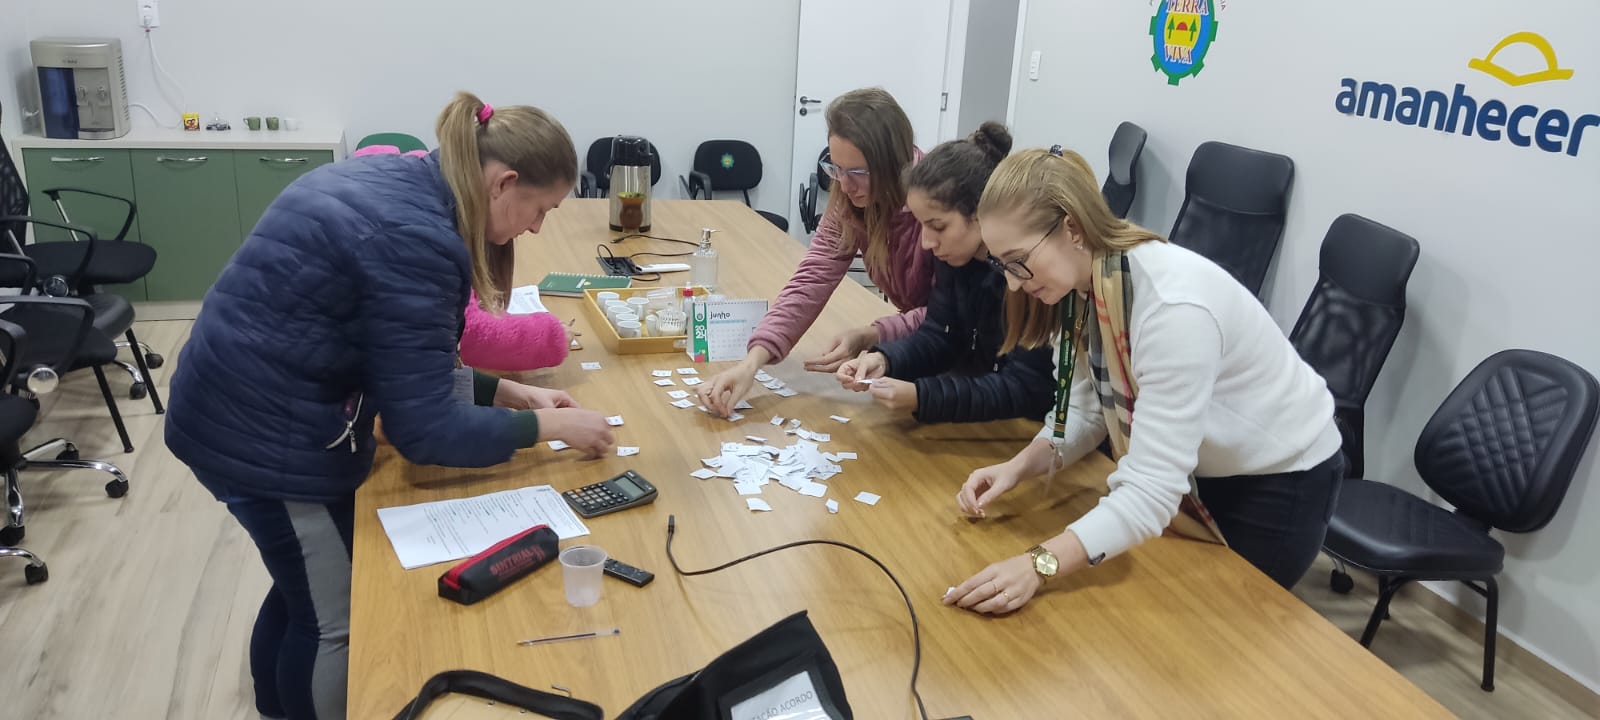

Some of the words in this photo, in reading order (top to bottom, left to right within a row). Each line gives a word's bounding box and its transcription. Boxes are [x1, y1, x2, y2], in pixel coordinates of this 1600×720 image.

[1166, 0, 1209, 15] TERRA
[1164, 45, 1193, 64] VIVA
[1335, 77, 1600, 157] amanhecer
[710, 311, 731, 320] junho
[780, 690, 813, 712] ACORDO
